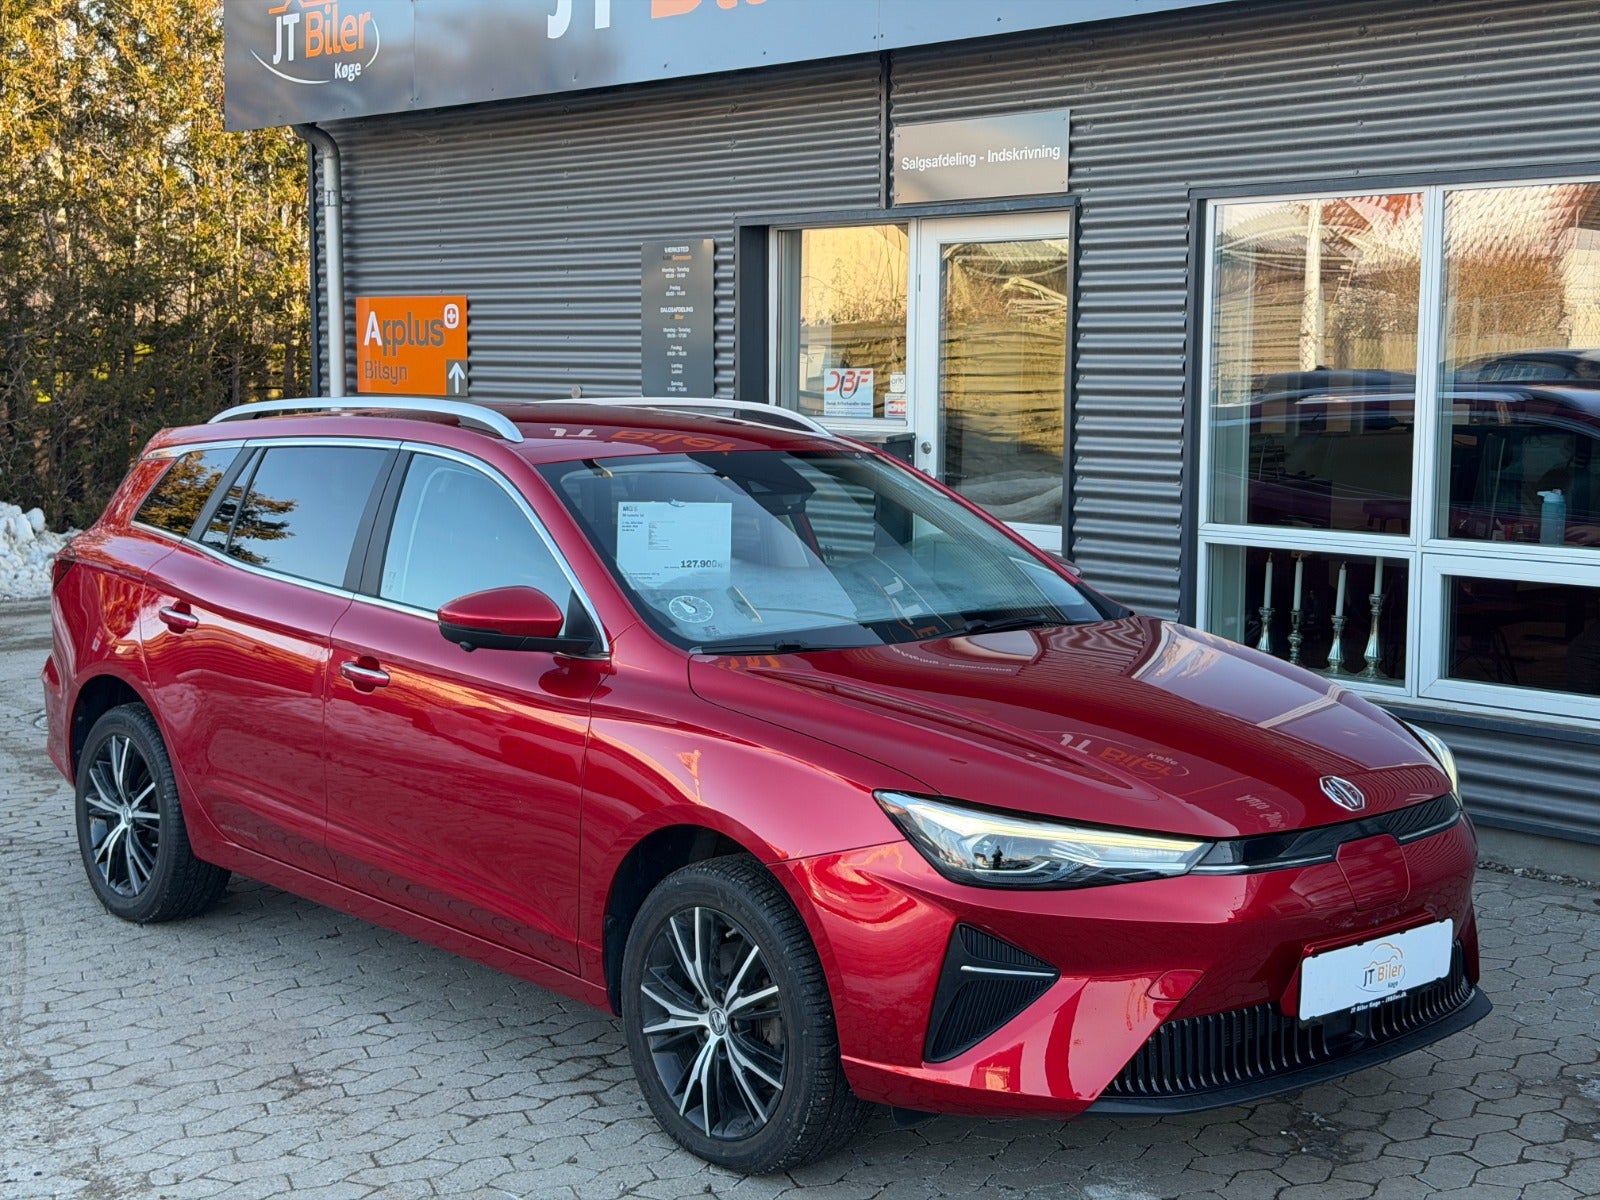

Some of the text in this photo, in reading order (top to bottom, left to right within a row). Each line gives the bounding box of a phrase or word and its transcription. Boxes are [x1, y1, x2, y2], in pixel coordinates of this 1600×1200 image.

[273, 3, 371, 65] JT Biler
[334, 62, 362, 81] Køge
[901, 152, 976, 171] Salgsafdeling
[987, 145, 1061, 163] Indskrivning
[364, 360, 408, 385] Bilsyn
[680, 560, 717, 568] 127.900
[1363, 964, 1402, 987] JT Biler
